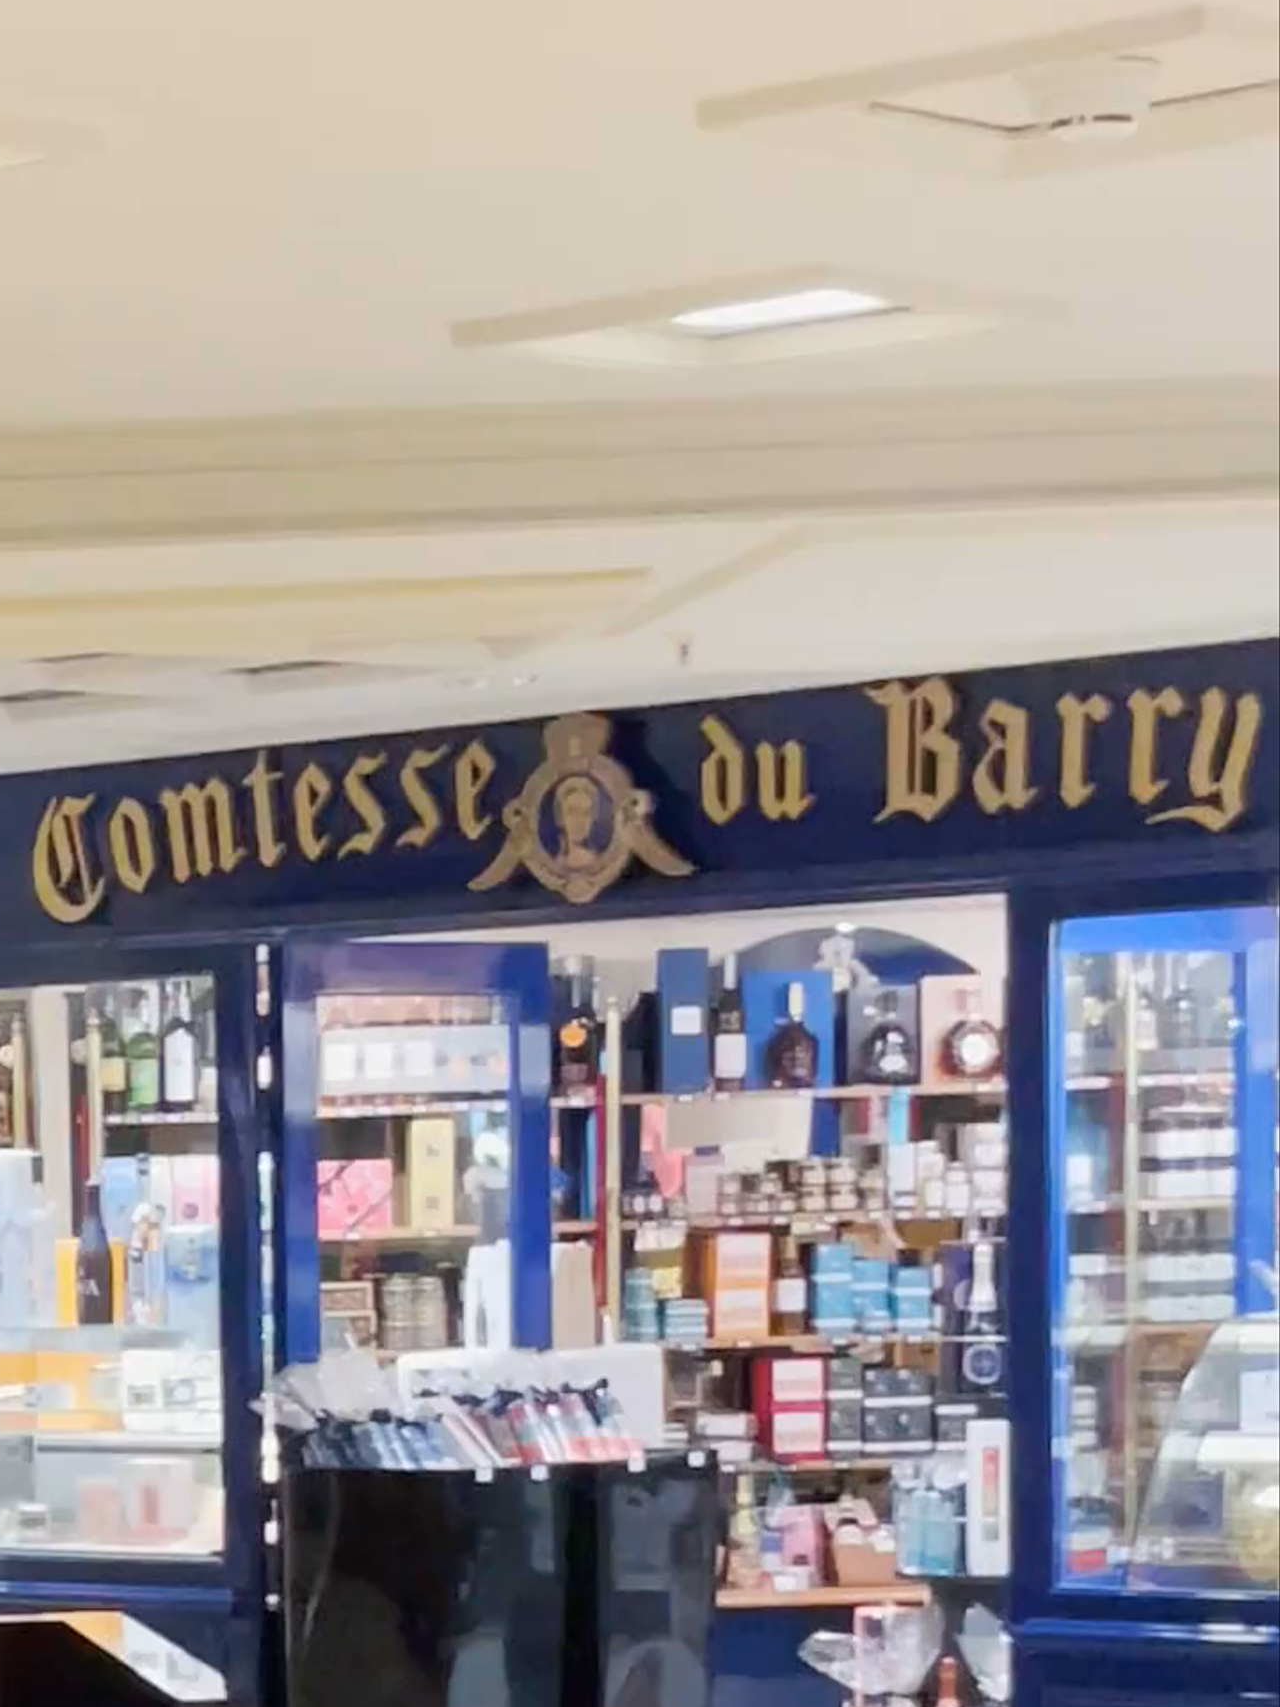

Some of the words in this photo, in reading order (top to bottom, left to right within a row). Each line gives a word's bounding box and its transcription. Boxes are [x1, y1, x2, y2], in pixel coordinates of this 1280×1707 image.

[32, 737, 497, 924] Comtesse
[699, 714, 816, 825] du
[863, 677, 1262, 833] Barry
